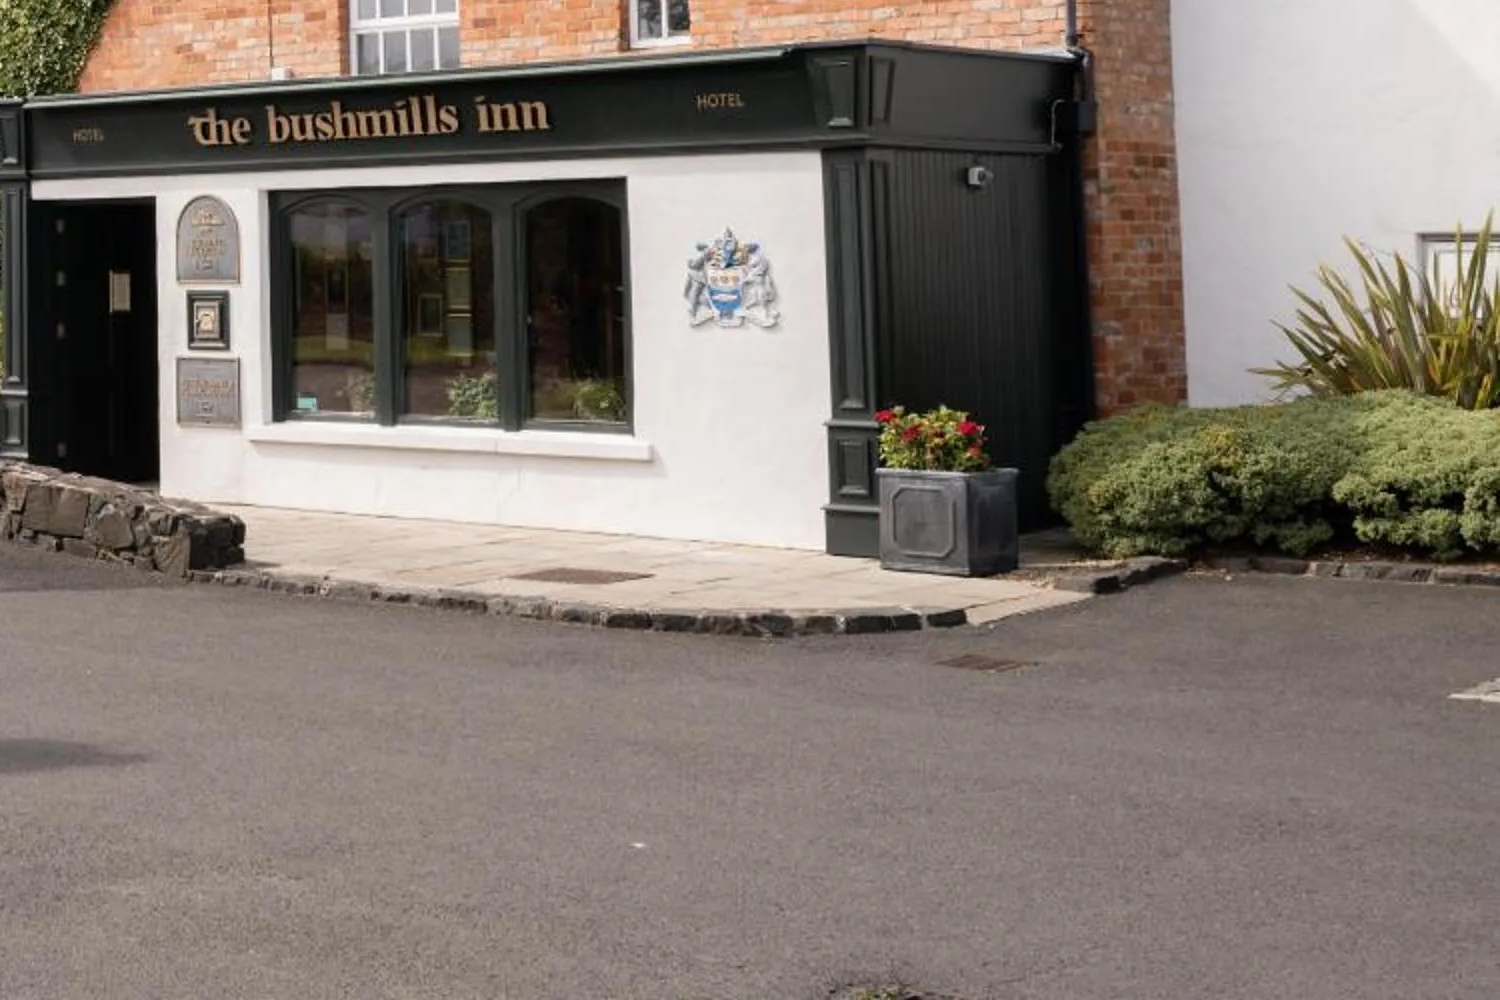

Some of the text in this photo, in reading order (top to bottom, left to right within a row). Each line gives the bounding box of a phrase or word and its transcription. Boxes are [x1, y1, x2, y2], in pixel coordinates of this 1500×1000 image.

[696, 93, 744, 109] HOTEL
[187, 95, 550, 146] the bushmills inn
